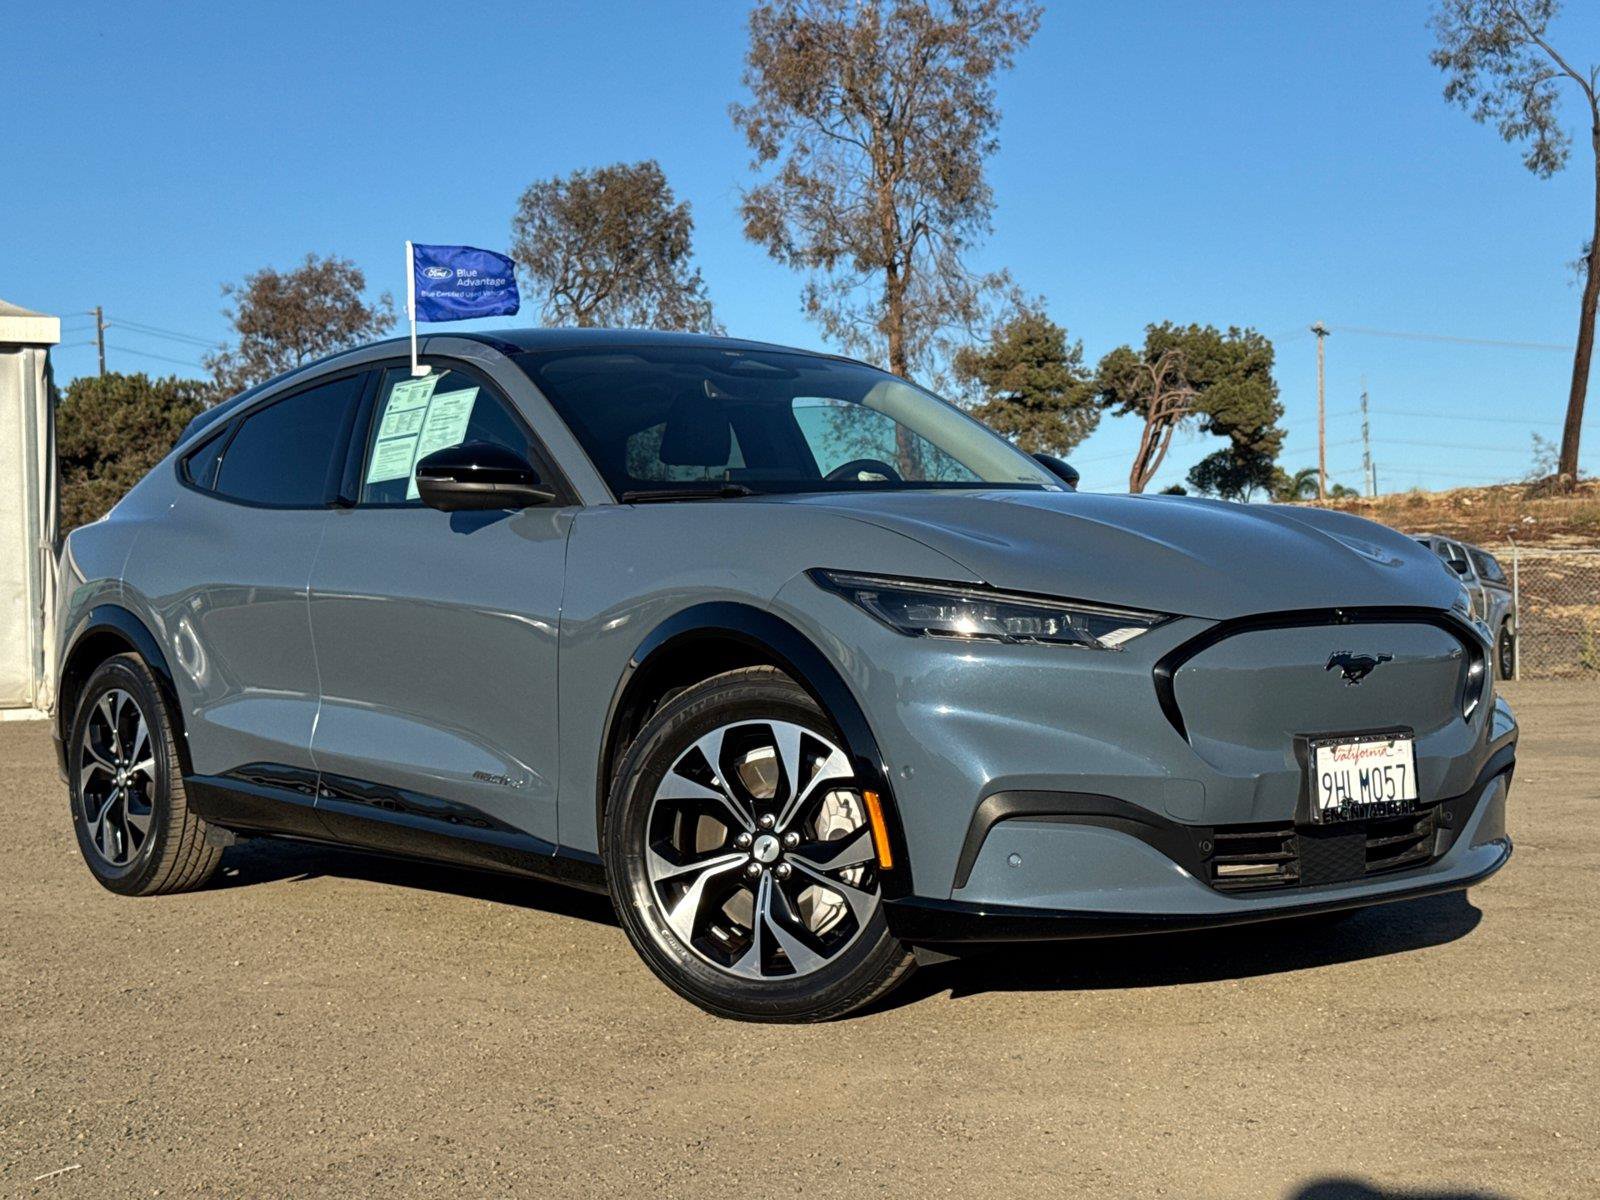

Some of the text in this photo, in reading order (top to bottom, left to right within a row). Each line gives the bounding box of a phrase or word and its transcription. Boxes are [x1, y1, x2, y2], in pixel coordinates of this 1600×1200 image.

[456, 269, 478, 278] Blue
[456, 279, 506, 287] Advantage
[1333, 745, 1388, 766] California
